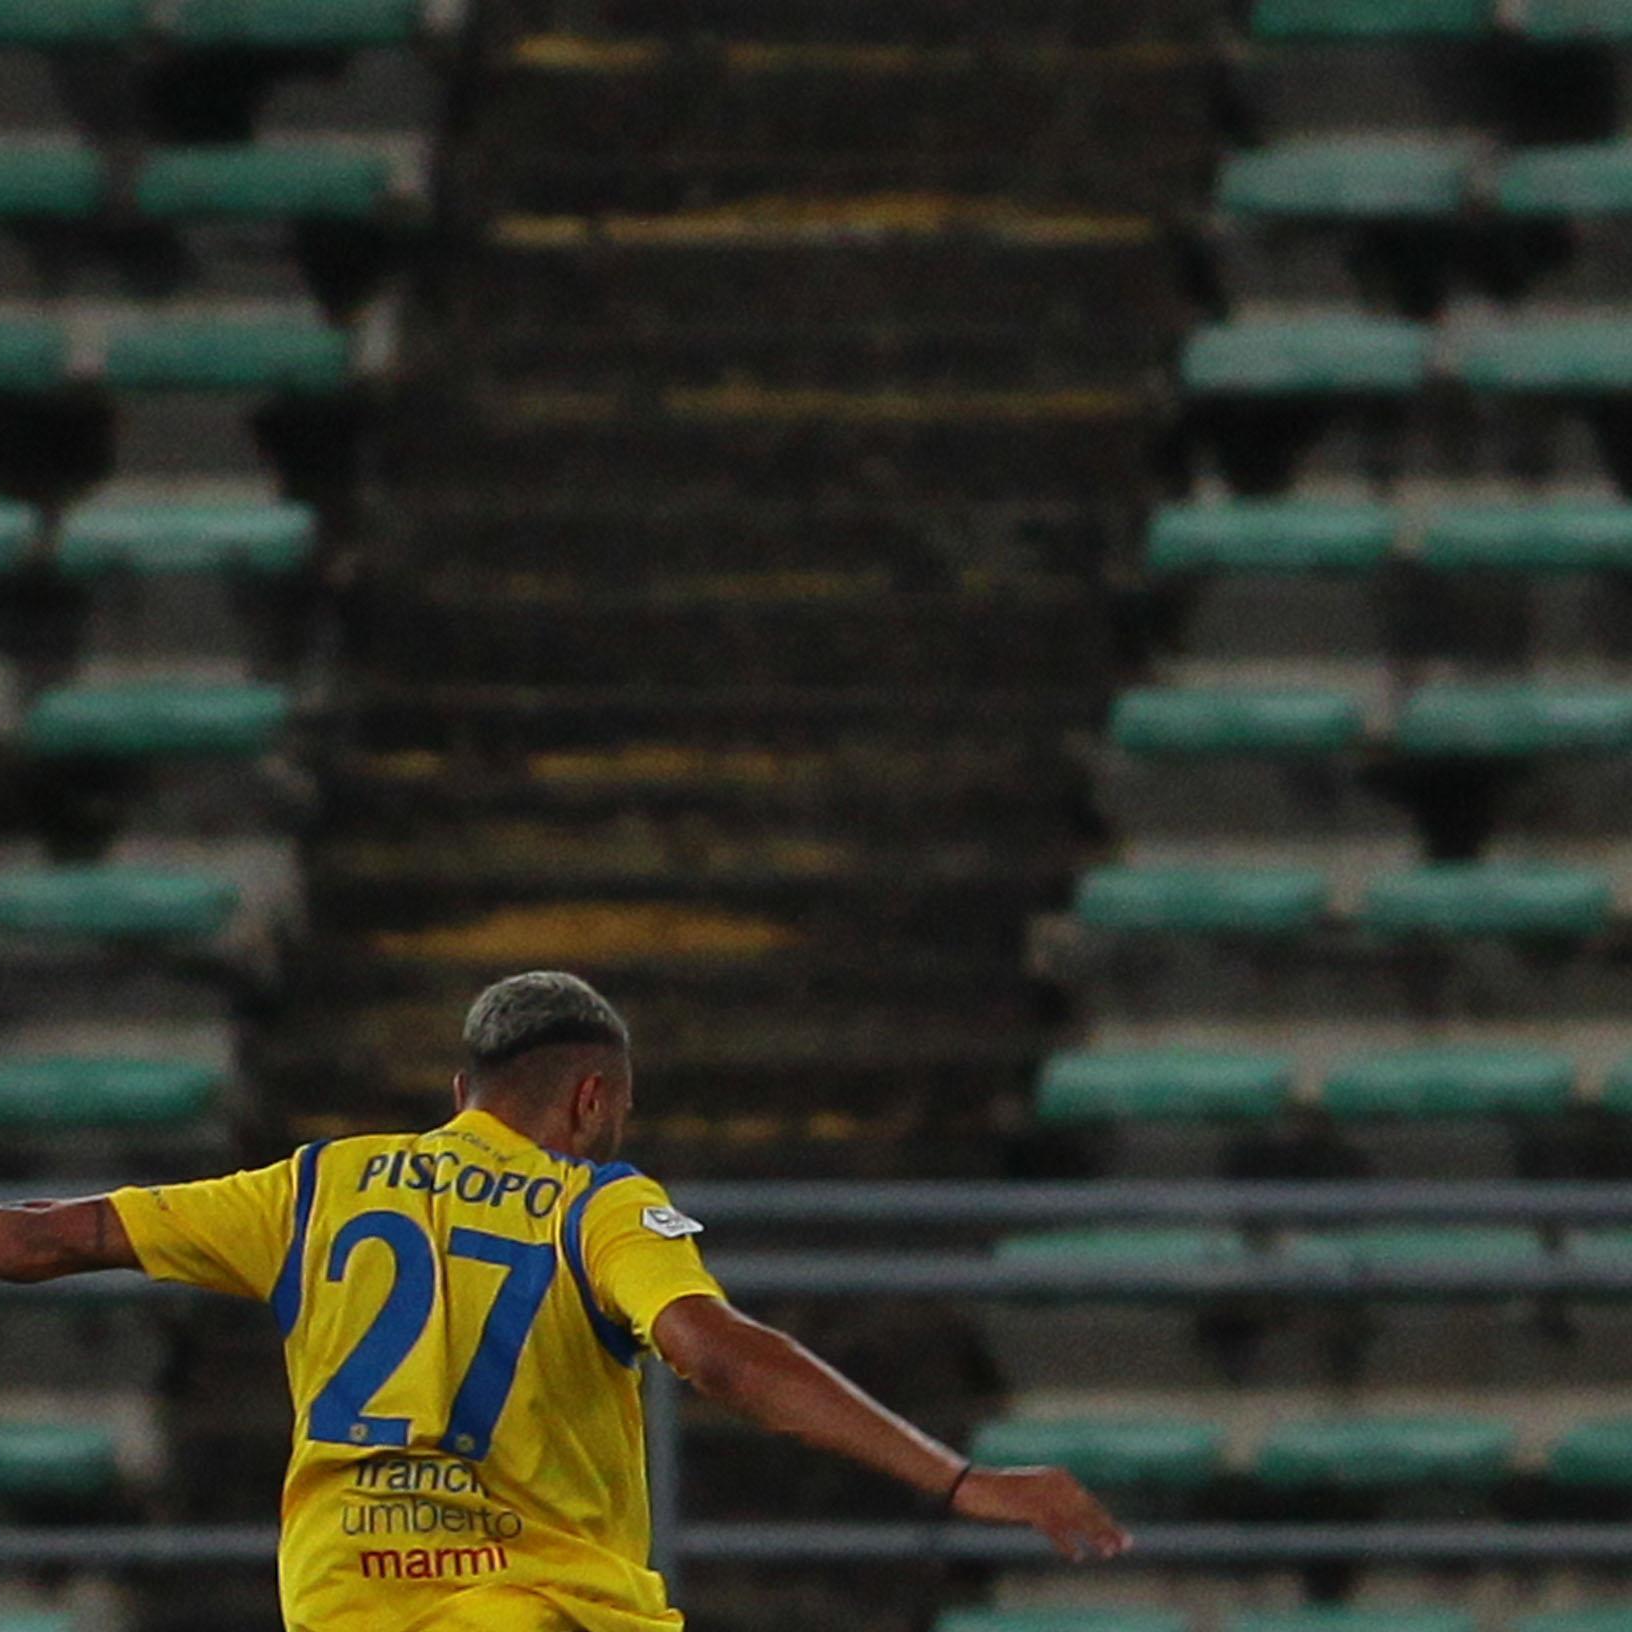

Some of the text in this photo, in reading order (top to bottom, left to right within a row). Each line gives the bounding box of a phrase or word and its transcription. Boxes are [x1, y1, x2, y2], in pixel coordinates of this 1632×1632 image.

[357, 1149, 563, 1219] PISCOPO
[308, 1210, 559, 1463] 27
[342, 1500, 523, 1540] umberto
[360, 1545, 508, 1579] marmi
